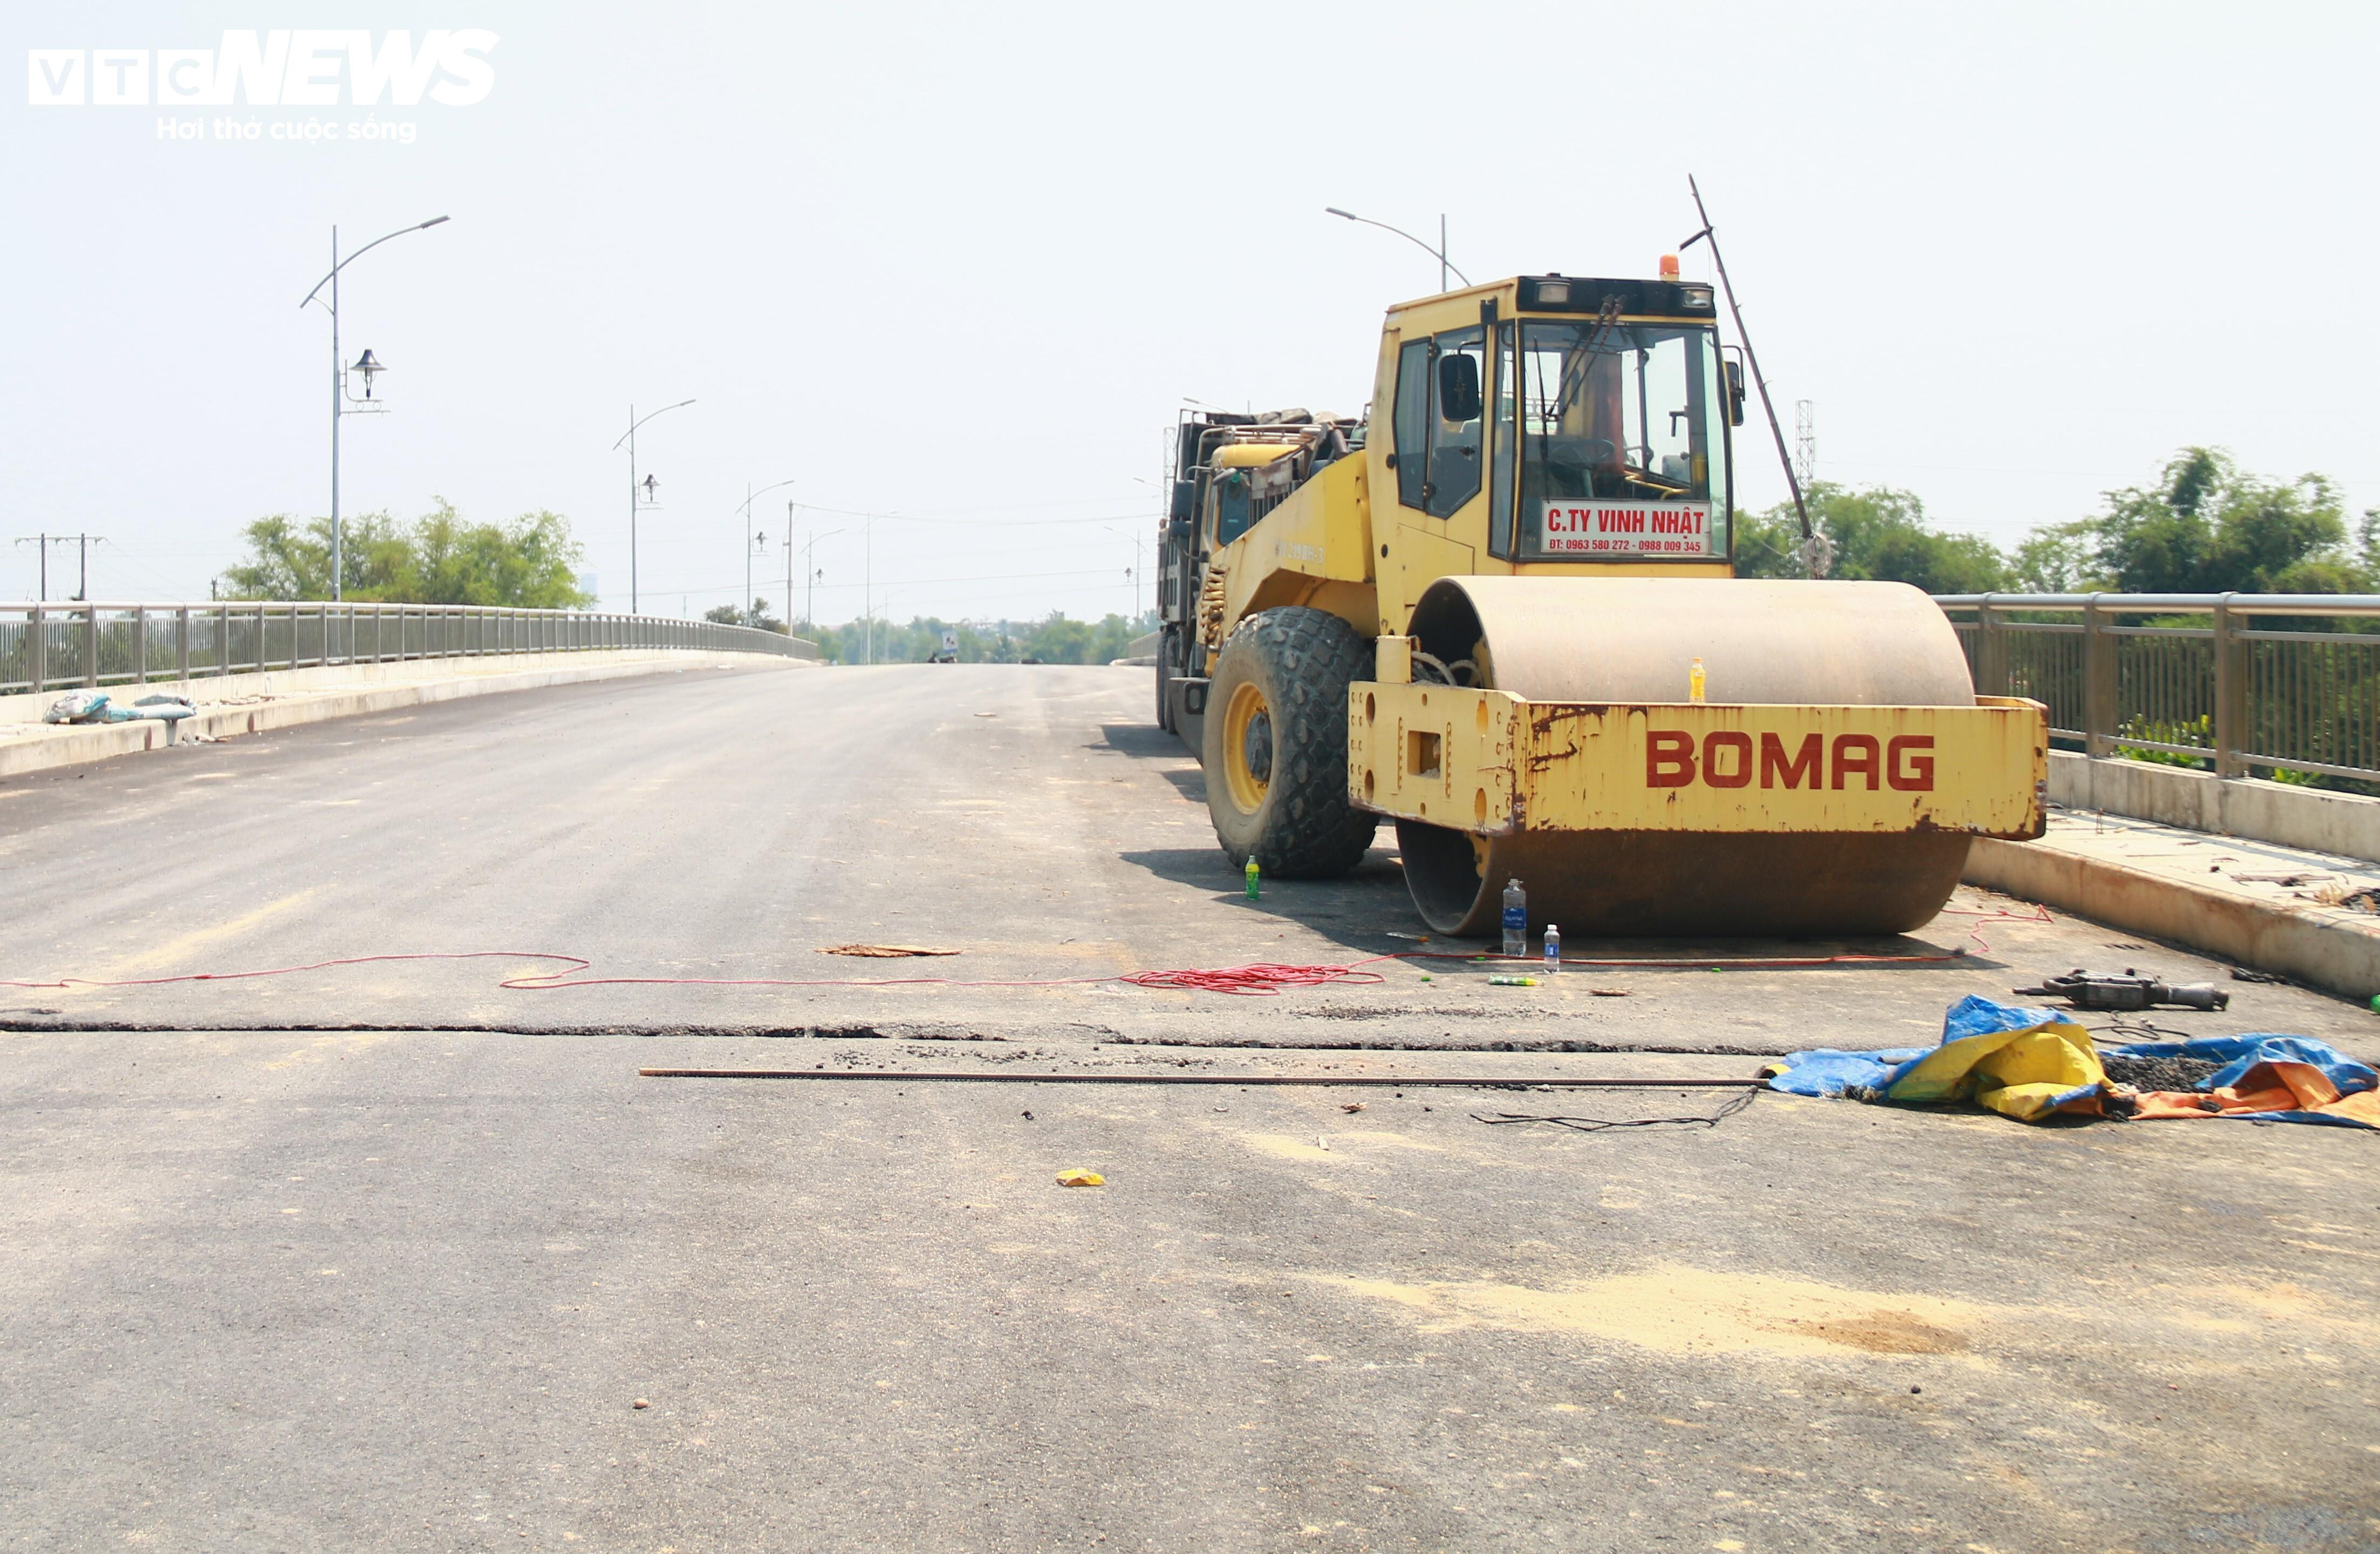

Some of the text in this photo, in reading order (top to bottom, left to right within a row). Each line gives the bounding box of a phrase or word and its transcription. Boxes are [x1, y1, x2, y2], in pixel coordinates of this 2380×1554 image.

[1548, 507, 1704, 539] C.TY VINH NHẬT
[1549, 539, 1563, 549] ĐT:
[1566, 540, 1589, 550] 0963
[1592, 540, 1610, 550] 580
[1612, 540, 1629, 550] 272
[1638, 540, 1661, 550] 0988
[1664, 541, 1681, 551] 009
[1684, 541, 1700, 551] 345
[1646, 730, 1934, 791] BOMAG
